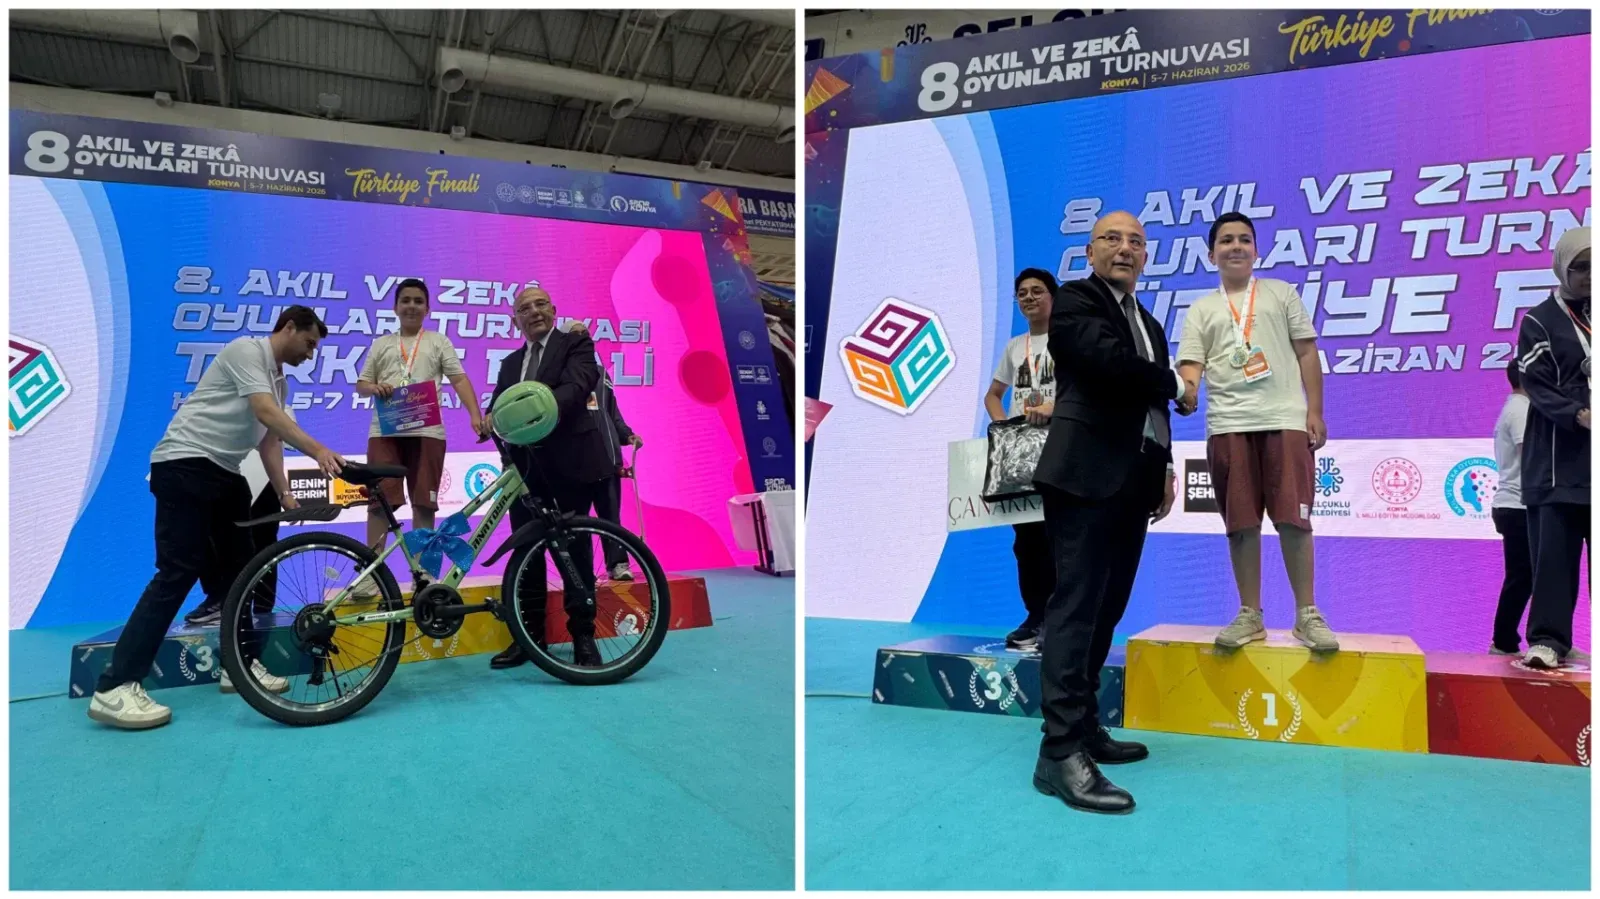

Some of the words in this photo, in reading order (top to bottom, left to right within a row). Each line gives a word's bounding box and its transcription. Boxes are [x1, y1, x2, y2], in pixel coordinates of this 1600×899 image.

[964, 50, 1024, 75] AKIL
[1031, 43, 1066, 65] VE
[1071, 26, 1141, 60] ZEKÂ
[1278, 10, 1394, 64] Türkiye
[962, 60, 1091, 95] OYUNLARI
[1100, 37, 1250, 76] TURNUVASI
[1100, 77, 1139, 89] KONYA
[1171, 66, 1220, 80] HAZİRAN
[1223, 62, 1251, 74] 2026
[75, 134, 135, 153] AKIL
[142, 140, 175, 156] VE
[181, 143, 241, 162] ZEKÂ
[74, 150, 199, 175] OYUNLARI
[206, 161, 326, 185] TURNUVASI
[207, 179, 240, 188] KONYA
[266, 183, 304, 193] HAZİRAN
[305, 186, 326, 195] 2026
[344, 167, 420, 204] Türkiye
[425, 166, 481, 196] Finali
[1137, 182, 1274, 226] AKIL
[1299, 169, 1392, 215] VE
[1056, 222, 1377, 282] OUNARI
[173, 265, 221, 294] 8.
[238, 269, 347, 300] AKIL
[437, 279, 540, 306] ZEK
[291, 391, 343, 410] 5-7
[290, 478, 327, 489] BENİM
[948, 494, 1042, 526] ÇANAKK
[1311, 508, 1351, 517] ELEDİYESİ
[195, 645, 214, 672] 3
[984, 671, 1002, 701] 3
[1261, 692, 1279, 726] 1
